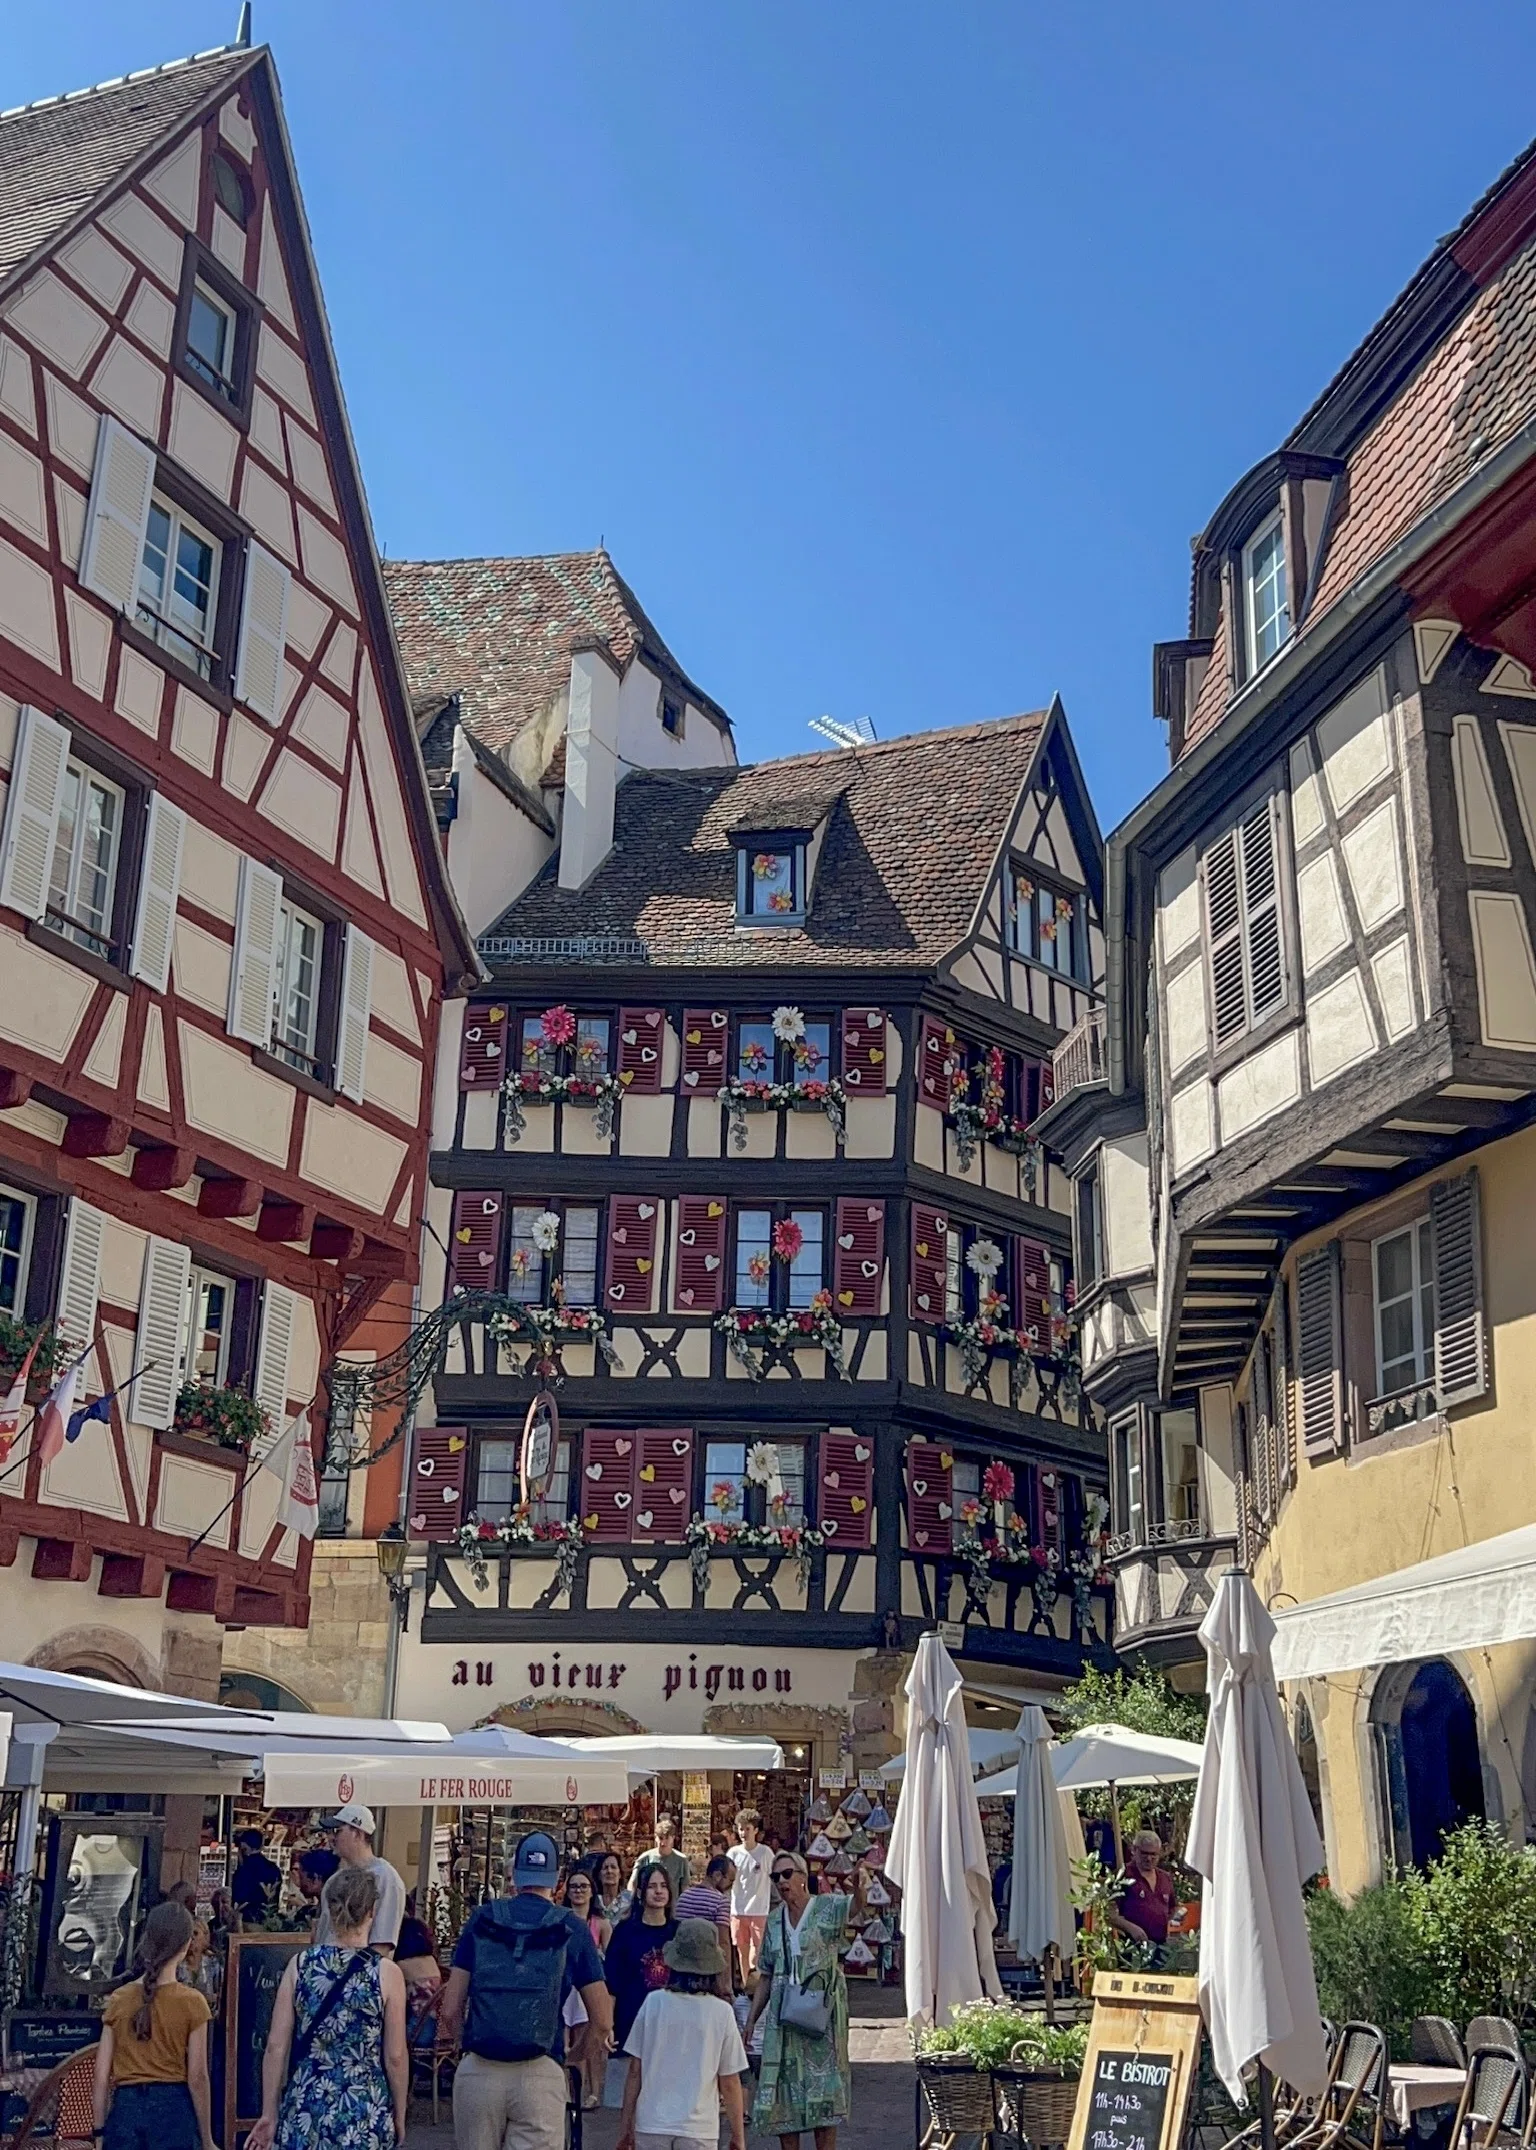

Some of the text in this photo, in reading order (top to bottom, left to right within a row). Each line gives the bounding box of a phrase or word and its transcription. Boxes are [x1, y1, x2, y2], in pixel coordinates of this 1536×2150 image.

[451, 1651, 792, 1702] au vieux pignon
[420, 1778, 513, 1799] LE FER ROUGE
[1099, 2061, 1117, 2080] LE
[1109, 2115, 1127, 2126] puis
